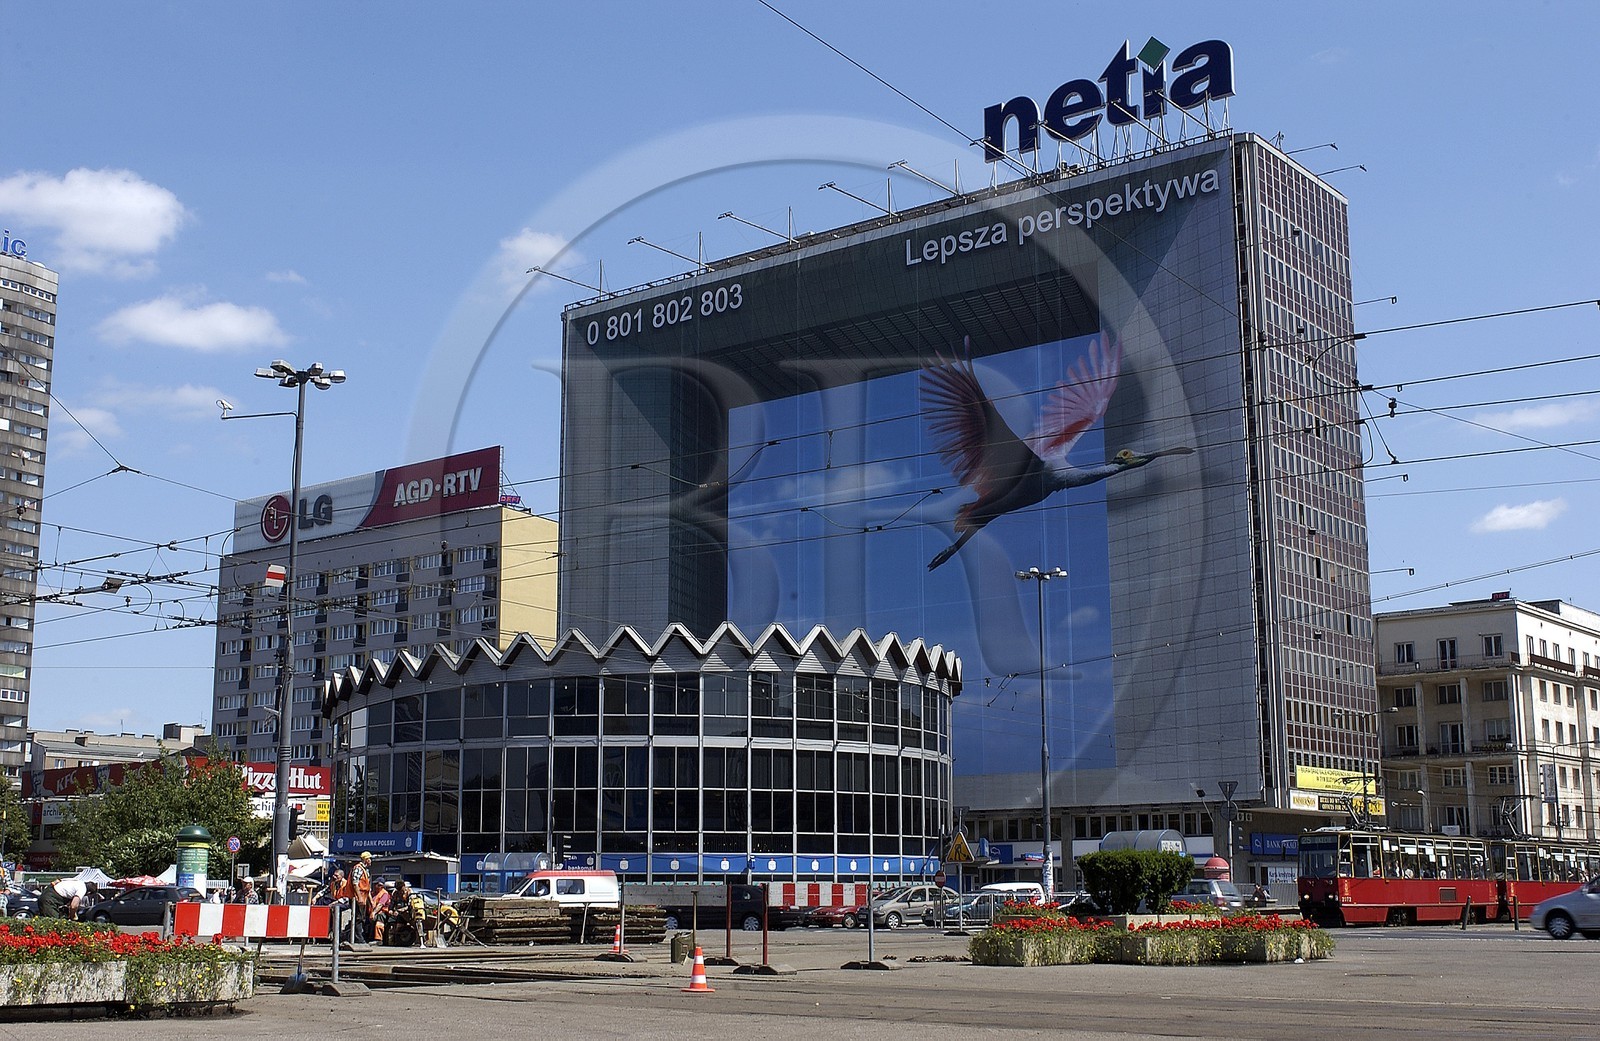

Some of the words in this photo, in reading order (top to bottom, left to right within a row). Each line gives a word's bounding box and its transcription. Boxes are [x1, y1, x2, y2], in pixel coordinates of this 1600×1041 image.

[983, 37, 1236, 163] netia
[905, 222, 1008, 266] Lepsza
[1018, 169, 1220, 245] perspektywa
[586, 320, 600, 345] 0
[606, 308, 643, 341] 801
[652, 296, 694, 329] 802
[700, 283, 743, 317] 803
[298, 494, 333, 530] LG
[1266, 840, 1281, 849] BANK
[1301, 836, 1312, 844] 25
